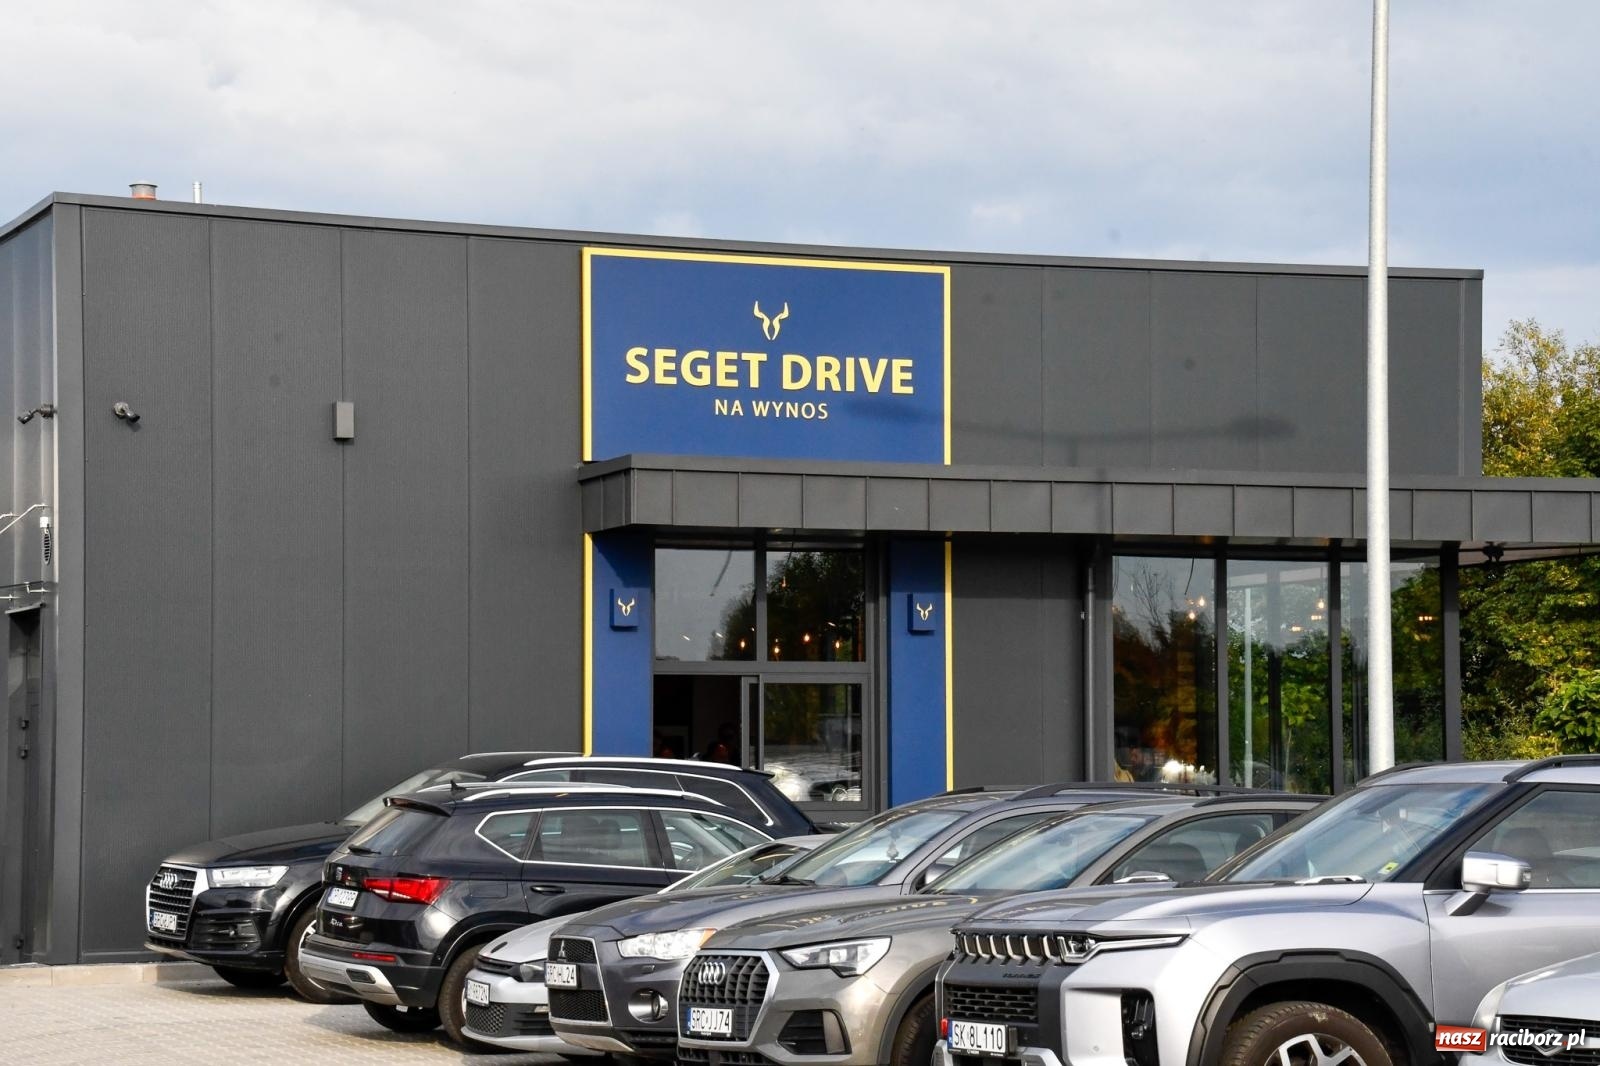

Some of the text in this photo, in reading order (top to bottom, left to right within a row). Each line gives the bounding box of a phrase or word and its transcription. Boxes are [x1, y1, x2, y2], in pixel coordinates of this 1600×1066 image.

[625, 346, 914, 394] SEGET DRIVE
[714, 399, 828, 420] NA WYNOS
[969, 1025, 1003, 1050] 8L110
